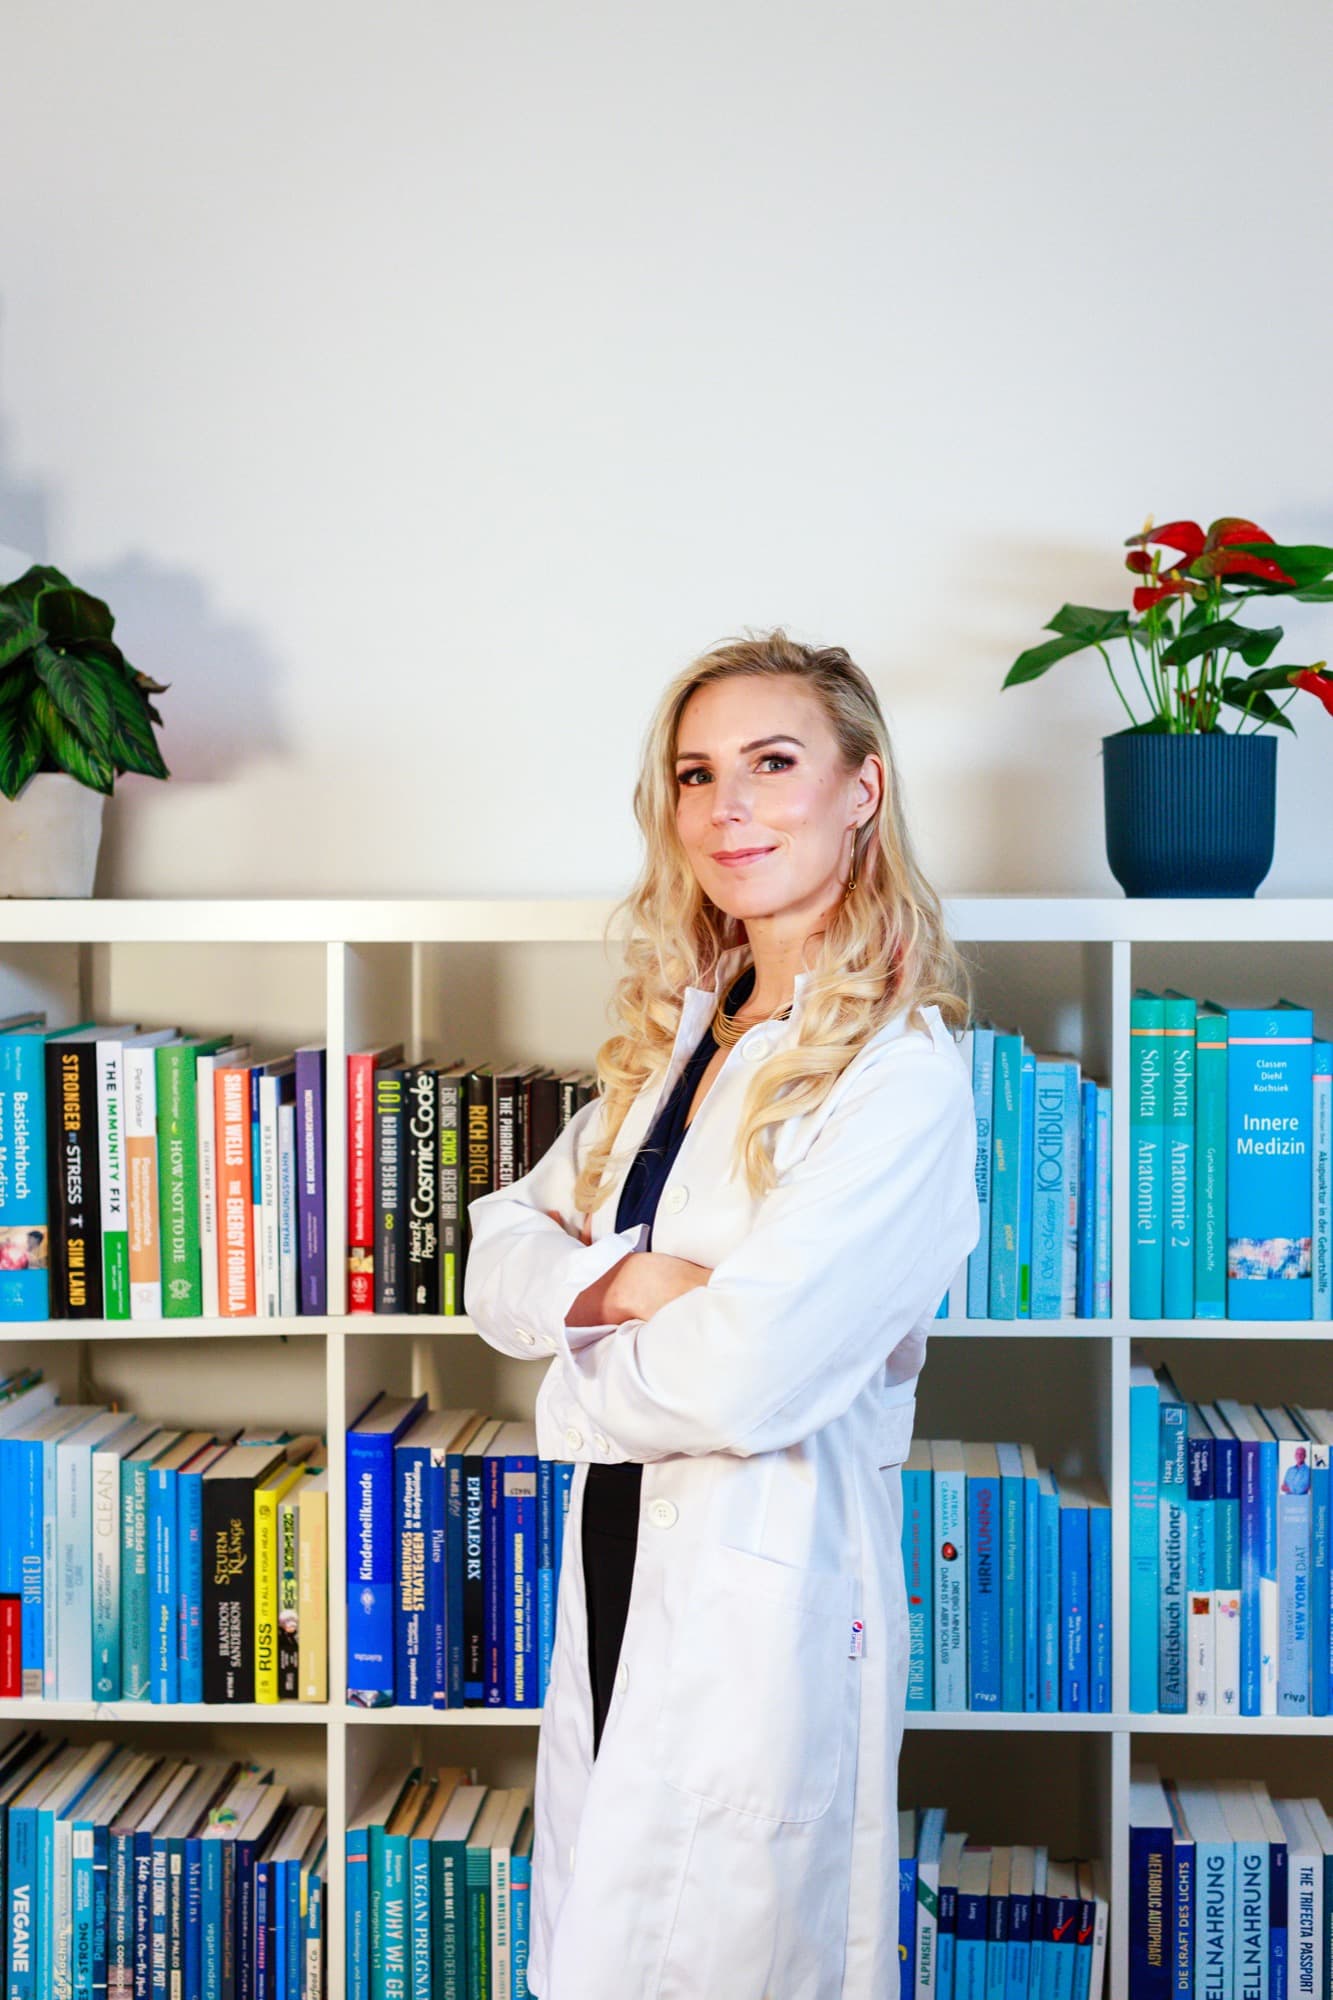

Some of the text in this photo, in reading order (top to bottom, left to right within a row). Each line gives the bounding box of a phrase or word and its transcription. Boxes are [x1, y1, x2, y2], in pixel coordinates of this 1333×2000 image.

[134, 1068, 144, 1128] Pete Walker
[1254, 1084, 1288, 1092] Kochsiek
[1261, 1072, 1282, 1080] Diehl
[62, 1054, 82, 1204] STRONGER STRESS
[223, 1074, 243, 1165] SHAWN WELLS
[442, 1106, 456, 1128] SIND
[499, 1096, 513, 1115] THE
[1244, 1114, 1299, 1130] Innere
[14, 1092, 30, 1199] Basislehrbuch
[106, 1061, 120, 1213] THE IMMUNITY FIX
[378, 1081, 401, 1208] DER SIEG ÜBER DEN TOD
[410, 1075, 434, 1217] Cosmic Code
[442, 1130, 456, 1165] COACH
[469, 1105, 488, 1184] RICH BITCH
[1037, 1089, 1063, 1192] KOCHBUCH
[1138, 1049, 1160, 1246] Sobotta Anatomie 1
[1171, 1049, 1192, 1247] Sobotta Anatomie 2
[1237, 1138, 1305, 1155] Medizin
[170, 1141, 185, 1262] HOW NOT TO DIE
[281, 1152, 290, 1254] ERNÄHRUNGSWAHN
[442, 1169, 456, 1201] BESTER
[1317, 1150, 1327, 1204] Akupunktur
[442, 1204, 456, 1219] IHR
[1207, 1202, 1216, 1218] und
[1318, 1219, 1327, 1233] der
[1319, 1207, 1327, 1216] in
[68, 1239, 85, 1305] SIIM LAND
[226, 1198, 246, 1311] ENERGY FORMULA
[410, 1230, 421, 1262] Heinz
[1318, 1236, 1327, 1293] Geburtshilfe
[1163, 1460, 1173, 1484] Haag
[1174, 1430, 1185, 1484] Grochowiak
[96, 1470, 114, 1537] CLEAN
[125, 1496, 134, 1549] WIE MAN
[135, 1470, 146, 1574] EIN PFERD FLIEGT
[359, 1473, 373, 1580] Kinderheilkunde
[466, 1477, 481, 1579] EPI-PALEO RX
[214, 1531, 230, 1584] STURM
[432, 1530, 444, 1563] Pilates
[977, 1488, 992, 1594] HIRNTUNING
[22, 1555, 42, 1604] SHRED
[262, 1575, 268, 1583] IN
[400, 1531, 413, 1611] ERNÄHRUNGS
[413, 1532, 424, 1611] STRATEGIEN
[940, 1567, 949, 1593] DANN
[941, 1607, 949, 1627] ABER
[1159, 1504, 1181, 1695] Arbeitsbuch Practitioner
[1295, 1575, 1307, 1640] NEW YORK
[219, 1602, 229, 1656] BRANDON
[230, 1601, 241, 1667] SANDERSON
[259, 1623, 272, 1671] RUSS
[952, 1614, 960, 1649] MINUTEN
[1283, 1691, 1306, 1703] riva
[117, 1836, 125, 1851] THE
[95, 1891, 106, 1926] vegan
[189, 1863, 200, 1923] Muffins
[414, 1863, 428, 1922] VEGAN
[444, 1872, 454, 1897] GABOR
[969, 1902, 977, 1919] Lang
[1148, 1853, 1163, 1966] METABOLIC AUTOPHAGY
[12, 1884, 30, 1973] VEGANE
[117, 1915, 125, 1941] PALEO
[153, 1852, 166, 1987] PALEO COOKING INSTANT POT
[386, 1900, 403, 1939] WHY
[1179, 1862, 1190, 1989] DIE KRAFT DES LICHTS
[1300, 1867, 1314, 1994] THE TRIFECTA PASSPORT
[78, 1923, 89, 1974] STRONG
[172, 1940, 180, 1968] PALEO
[206, 1923, 216, 1988] vegan under
[386, 1945, 403, 1972] WE
[920, 1927, 932, 1986] ALPENSEEN
